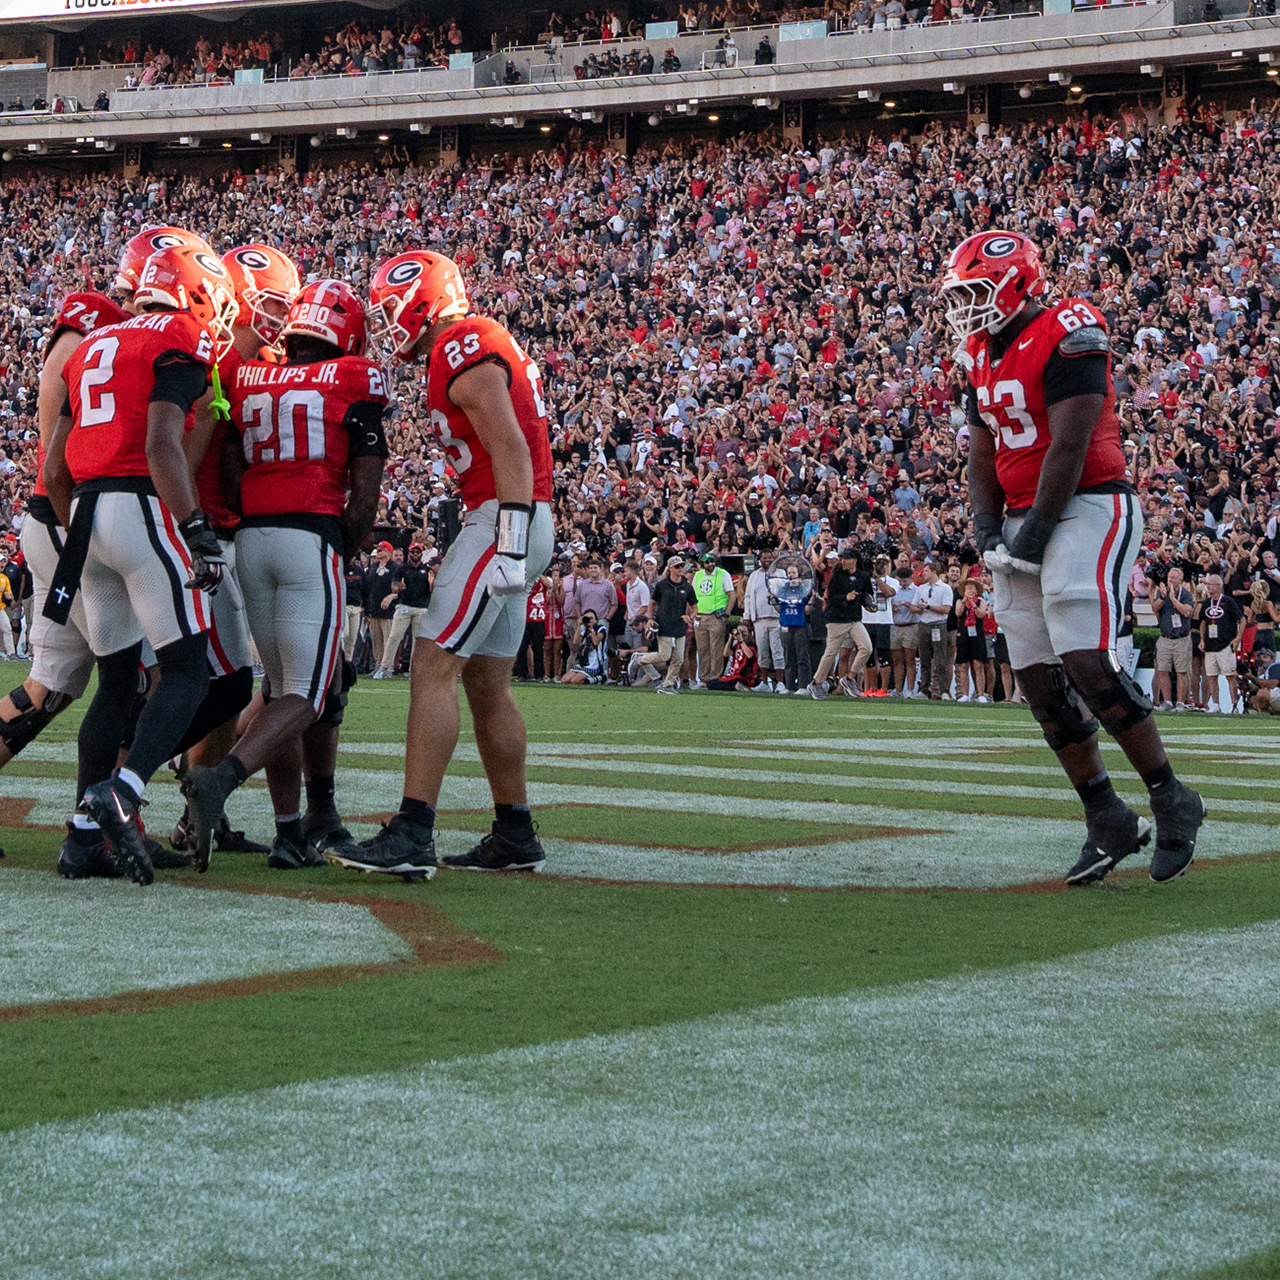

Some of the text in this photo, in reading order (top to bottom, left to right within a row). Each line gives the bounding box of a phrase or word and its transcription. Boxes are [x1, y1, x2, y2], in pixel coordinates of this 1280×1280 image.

[983, 237, 1016, 258] G
[146, 265, 157, 283] 2
[387, 261, 422, 285] G
[63, 301, 100, 331] 74
[1057, 304, 1097, 333] 63
[196, 330, 213, 360] 2
[444, 333, 480, 370] 23
[80, 336, 119, 427] 2
[236, 362, 340, 389] PHILLIPS JR.
[241, 389, 325, 464] 20
[529, 607, 546, 619] 44
